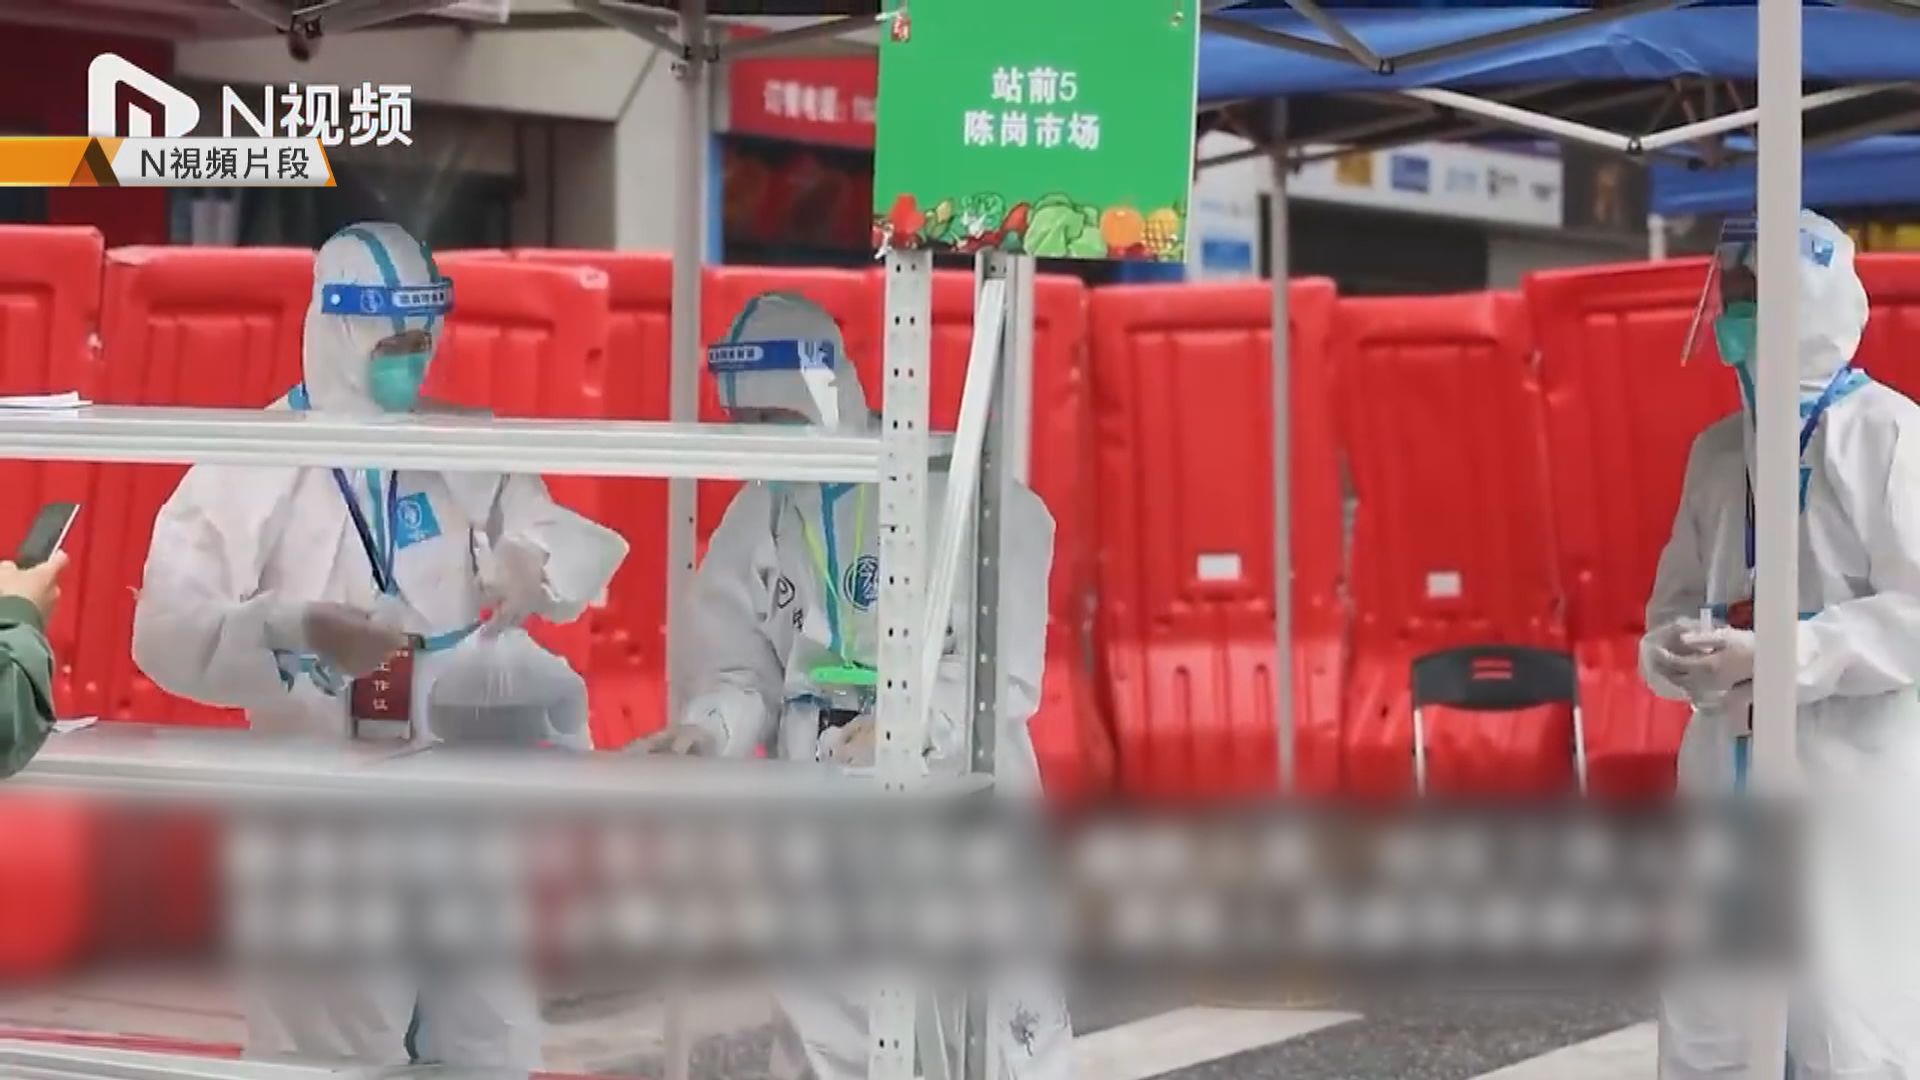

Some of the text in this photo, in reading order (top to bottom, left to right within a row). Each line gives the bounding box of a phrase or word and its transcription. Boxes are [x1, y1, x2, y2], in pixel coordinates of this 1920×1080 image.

[991, 66, 1078, 104] 站前5
[963, 110, 1100, 150] 陈岗市场
